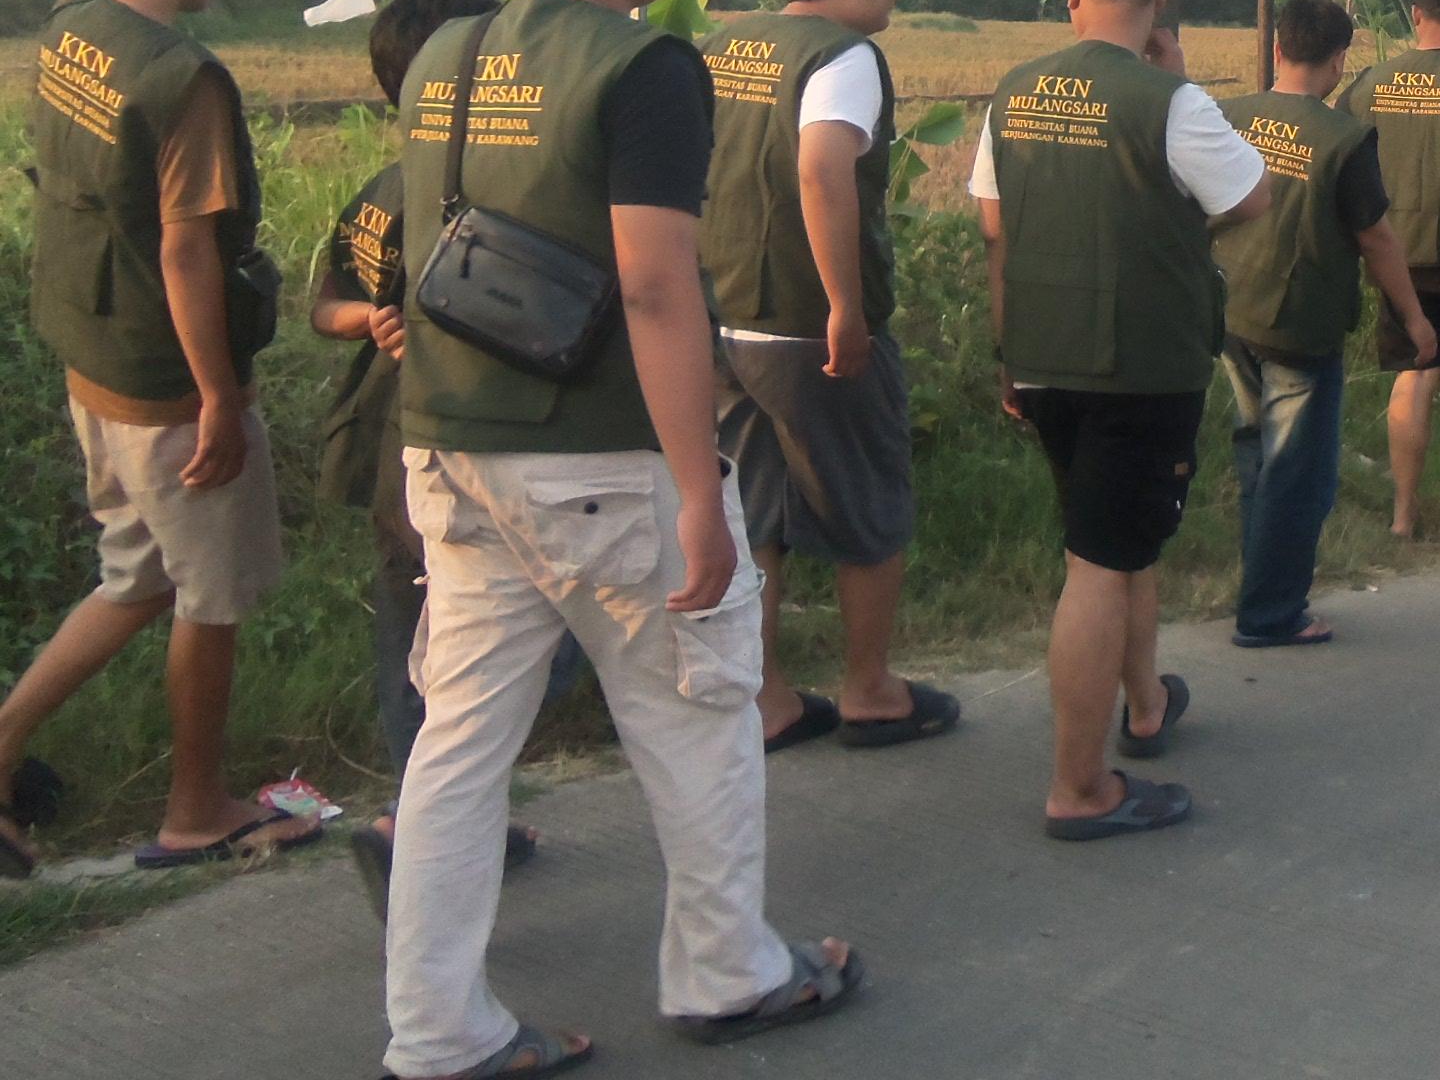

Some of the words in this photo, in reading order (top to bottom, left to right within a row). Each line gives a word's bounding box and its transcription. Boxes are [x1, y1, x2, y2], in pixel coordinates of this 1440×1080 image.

[57, 31, 115, 78] KKN
[724, 39, 776, 59] KKN
[1033, 75, 1093, 98] KKN
[1392, 72, 1436, 87] KKN
[420, 82, 543, 103] MUNGSARI
[1008, 96, 1108, 117] MULANGSARI
[489, 117, 528, 130] BUANA
[1007, 119, 1065, 133] UNIVERSITAS
[1068, 125, 1099, 136] BUANA
[1249, 116, 1300, 140] KKN
[1001, 130, 1055, 142] PERJUANGAN
[1057, 136, 1108, 148] KARAWANG
[1276, 158, 1304, 171] BUANA
[353, 202, 392, 237] KKN
